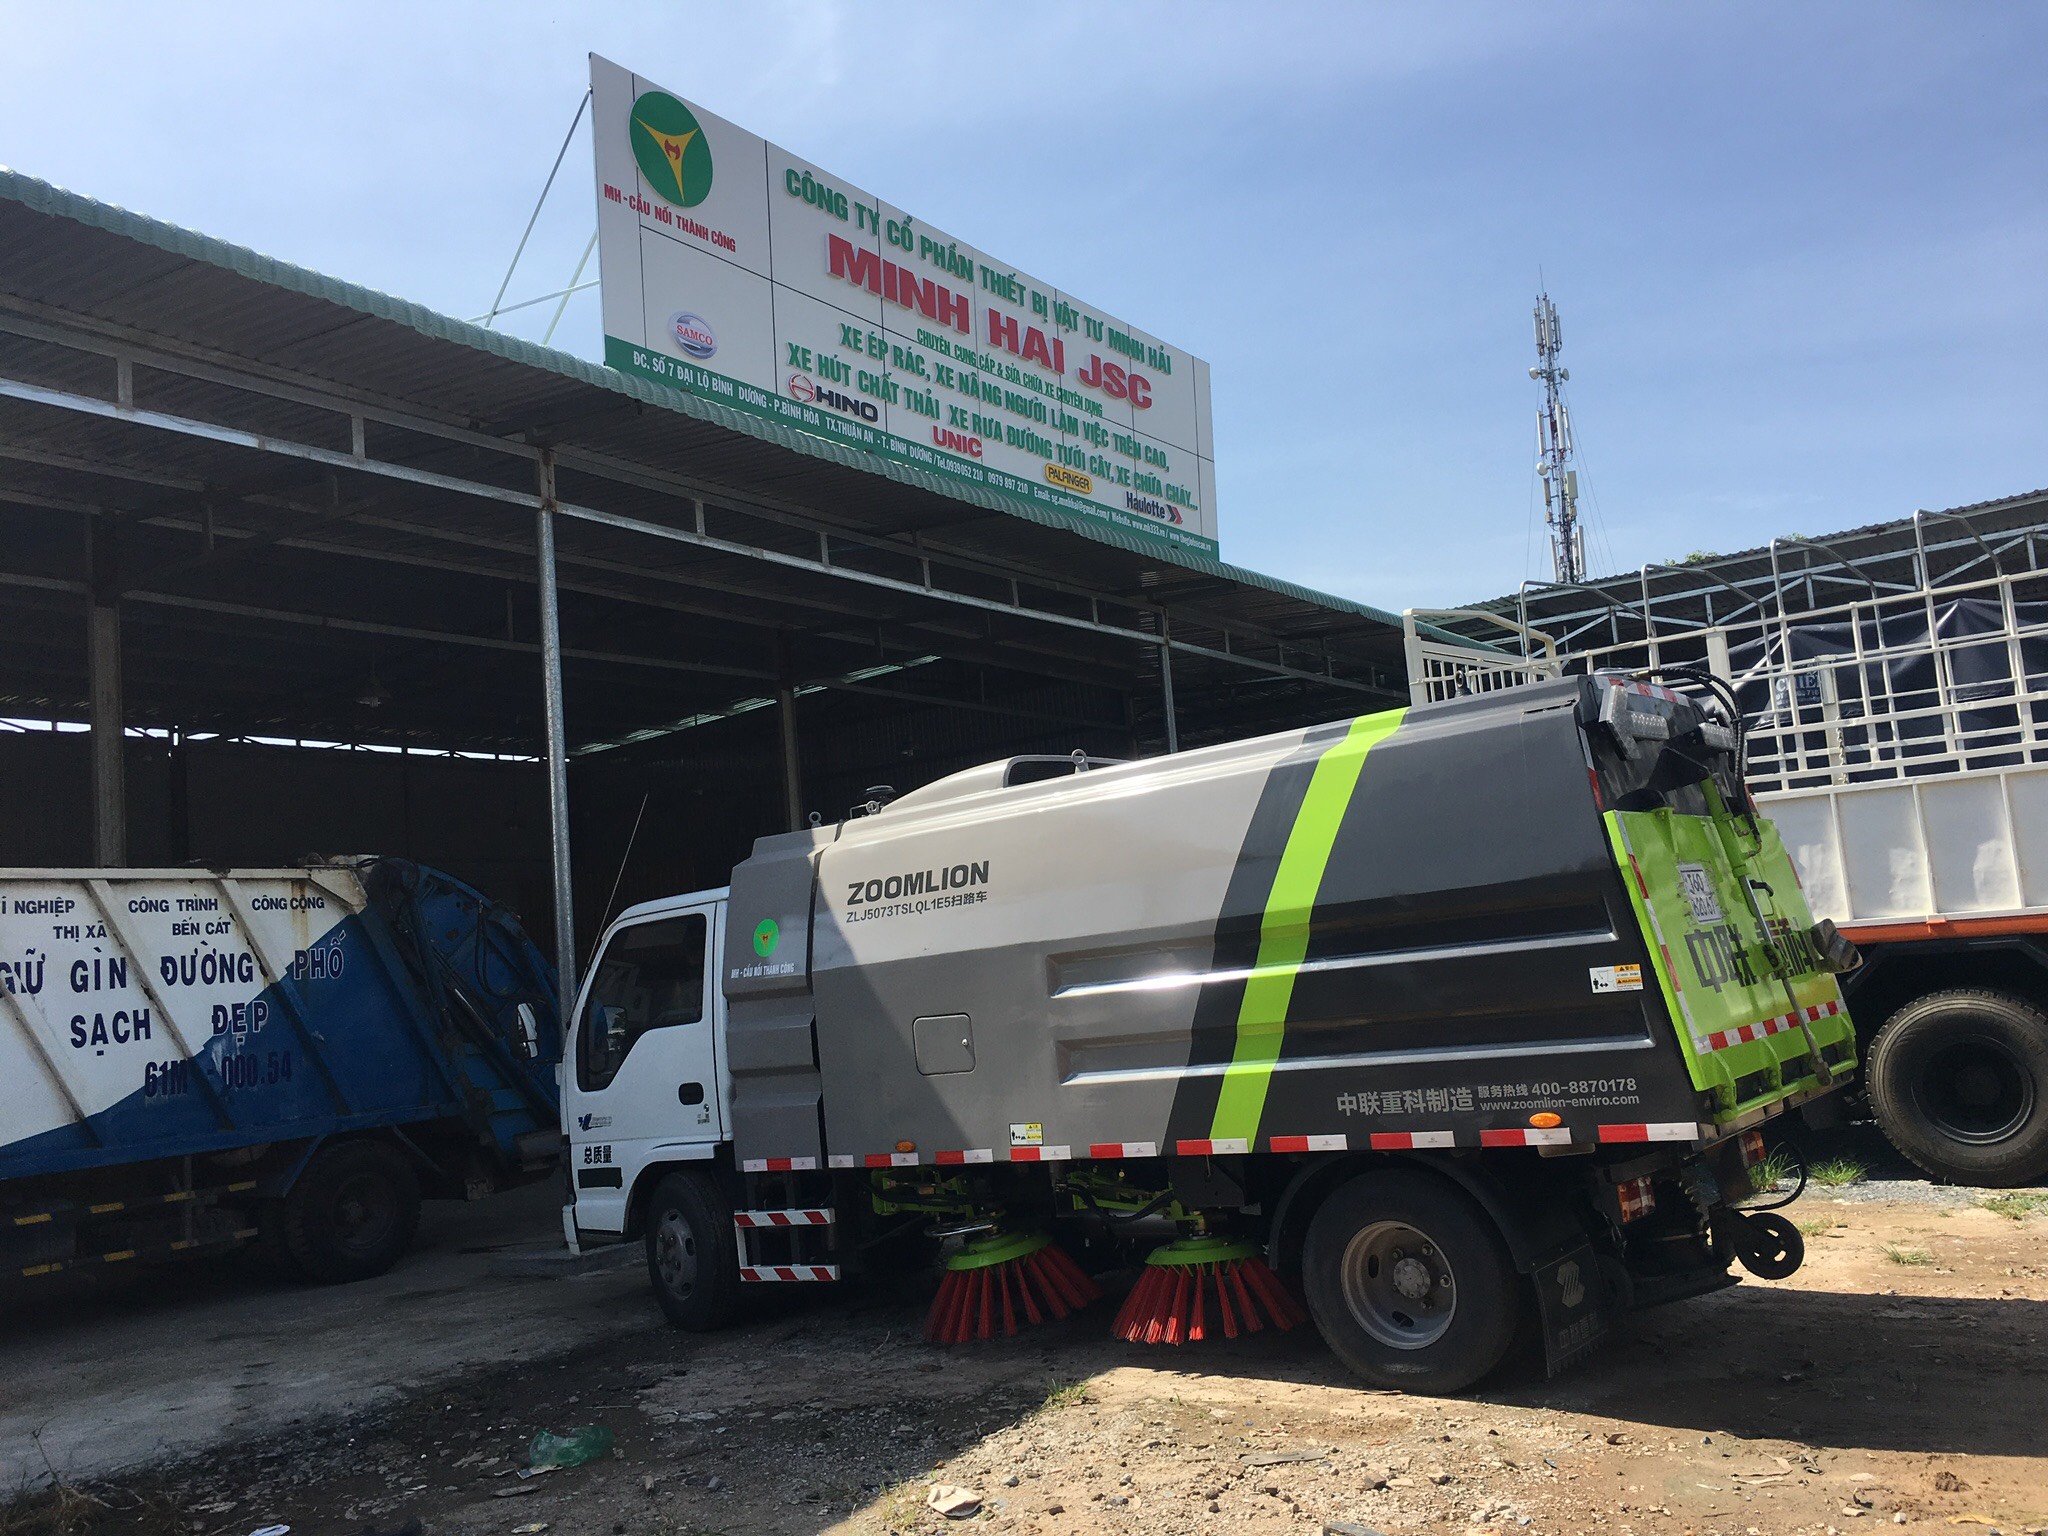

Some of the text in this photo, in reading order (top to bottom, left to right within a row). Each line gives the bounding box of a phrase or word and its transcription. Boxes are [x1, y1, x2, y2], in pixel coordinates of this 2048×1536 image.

[604, 184, 621, 204] MH
[654, 205, 673, 226] NỐI
[675, 214, 709, 241] THÀNH
[711, 230, 736, 253] CÔNG
[785, 168, 849, 222] CÔNG
[854, 201, 880, 236] TY
[886, 215, 914, 252] CỔ
[979, 264, 1027, 307] THIẾT
[1031, 290, 1048, 323] BỊ
[1052, 300, 1080, 333] VẬT
[1083, 315, 1104, 342] TƯ
[1107, 326, 1146, 363] MINH
[1147, 345, 1172, 375] HẢI
[676, 324, 713, 346] SAMCO
[827, 233, 1153, 409] MINH HAI JSC
[916, 328, 951, 359] CHUYÊN
[954, 344, 977, 367] CUNG
[979, 352, 996, 373] CẤP
[997, 363, 1004, 377] &
[1005, 363, 1020, 384] SỬA
[1022, 372, 1043, 395] CHỮA
[1044, 380, 1055, 397] XE
[1084, 398, 1103, 418] DỤNG
[816, 385, 878, 422] HINO
[840, 322, 864, 353] XE
[866, 331, 889, 361] ÉP
[893, 344, 931, 383] RÁC,
[934, 361, 955, 389] XE
[1004, 390, 1047, 425] NGƯỜI
[1051, 407, 1079, 437] LÀM
[1083, 420, 1109, 449] VIỆC
[1113, 432, 1142, 460] TRÊN
[1145, 445, 1170, 472] CAO,
[633, 350, 650, 369] ĐC.
[653, 356, 666, 374] SỐ
[668, 362, 674, 377] 7
[677, 365, 693, 386] ĐẠI
[697, 371, 709, 391] LỘ
[712, 376, 734, 397] BÌNH
[738, 386, 767, 409] DƯƠNG
[803, 407, 820, 427] HÒA
[863, 429, 874, 444] AN
[890, 437, 907, 456] BÌNH
[973, 468, 984, 482] 210
[988, 472, 1003, 487] 0979
[1004, 478, 1016, 490] 897
[1017, 481, 1029, 495] 210
[787, 341, 813, 373] XE
[817, 353, 852, 387] HÚT
[858, 369, 900, 405] CHẤT
[903, 387, 940, 420] THẢI
[948, 404, 969, 430] XE
[1006, 425, 1053, 460] ĐƯỜNG
[1055, 443, 1086, 471] TƯỚI
[1089, 454, 1115, 484] CÂY,
[1116, 465, 1131, 487] XE
[1134, 471, 1164, 498] CHỮA
[932, 425, 983, 458] UNIC
[1047, 466, 1091, 491] PALFINGER
[1126, 491, 1166, 519] Haulotte
[847, 860, 990, 906] ZOOMLION
[14, 896, 75, 917] NGHIỆP
[128, 896, 170, 913] CÔNG
[176, 894, 219, 911] TRÌNH
[252, 894, 289, 911] CÔNG
[290, 897, 325, 914] CỘNG
[53, 915, 231, 942] THỊ XÃ BẾN CÁT
[70, 946, 127, 993] GÌN
[160, 941, 254, 986] ĐƯỜNG
[293, 930, 347, 981] PHỐ
[70, 1000, 269, 1056] SẠCH ĐẸP
[145, 1059, 189, 1098] 61M
[1477, 1078, 1637, 1099] 服务热线 400-8870178
[1336, 1086, 1475, 1117] 中联重科制造
[1479, 1094, 1640, 1111] www.zoomlion-enviro.com
[584, 1144, 612, 1165] 总质量
